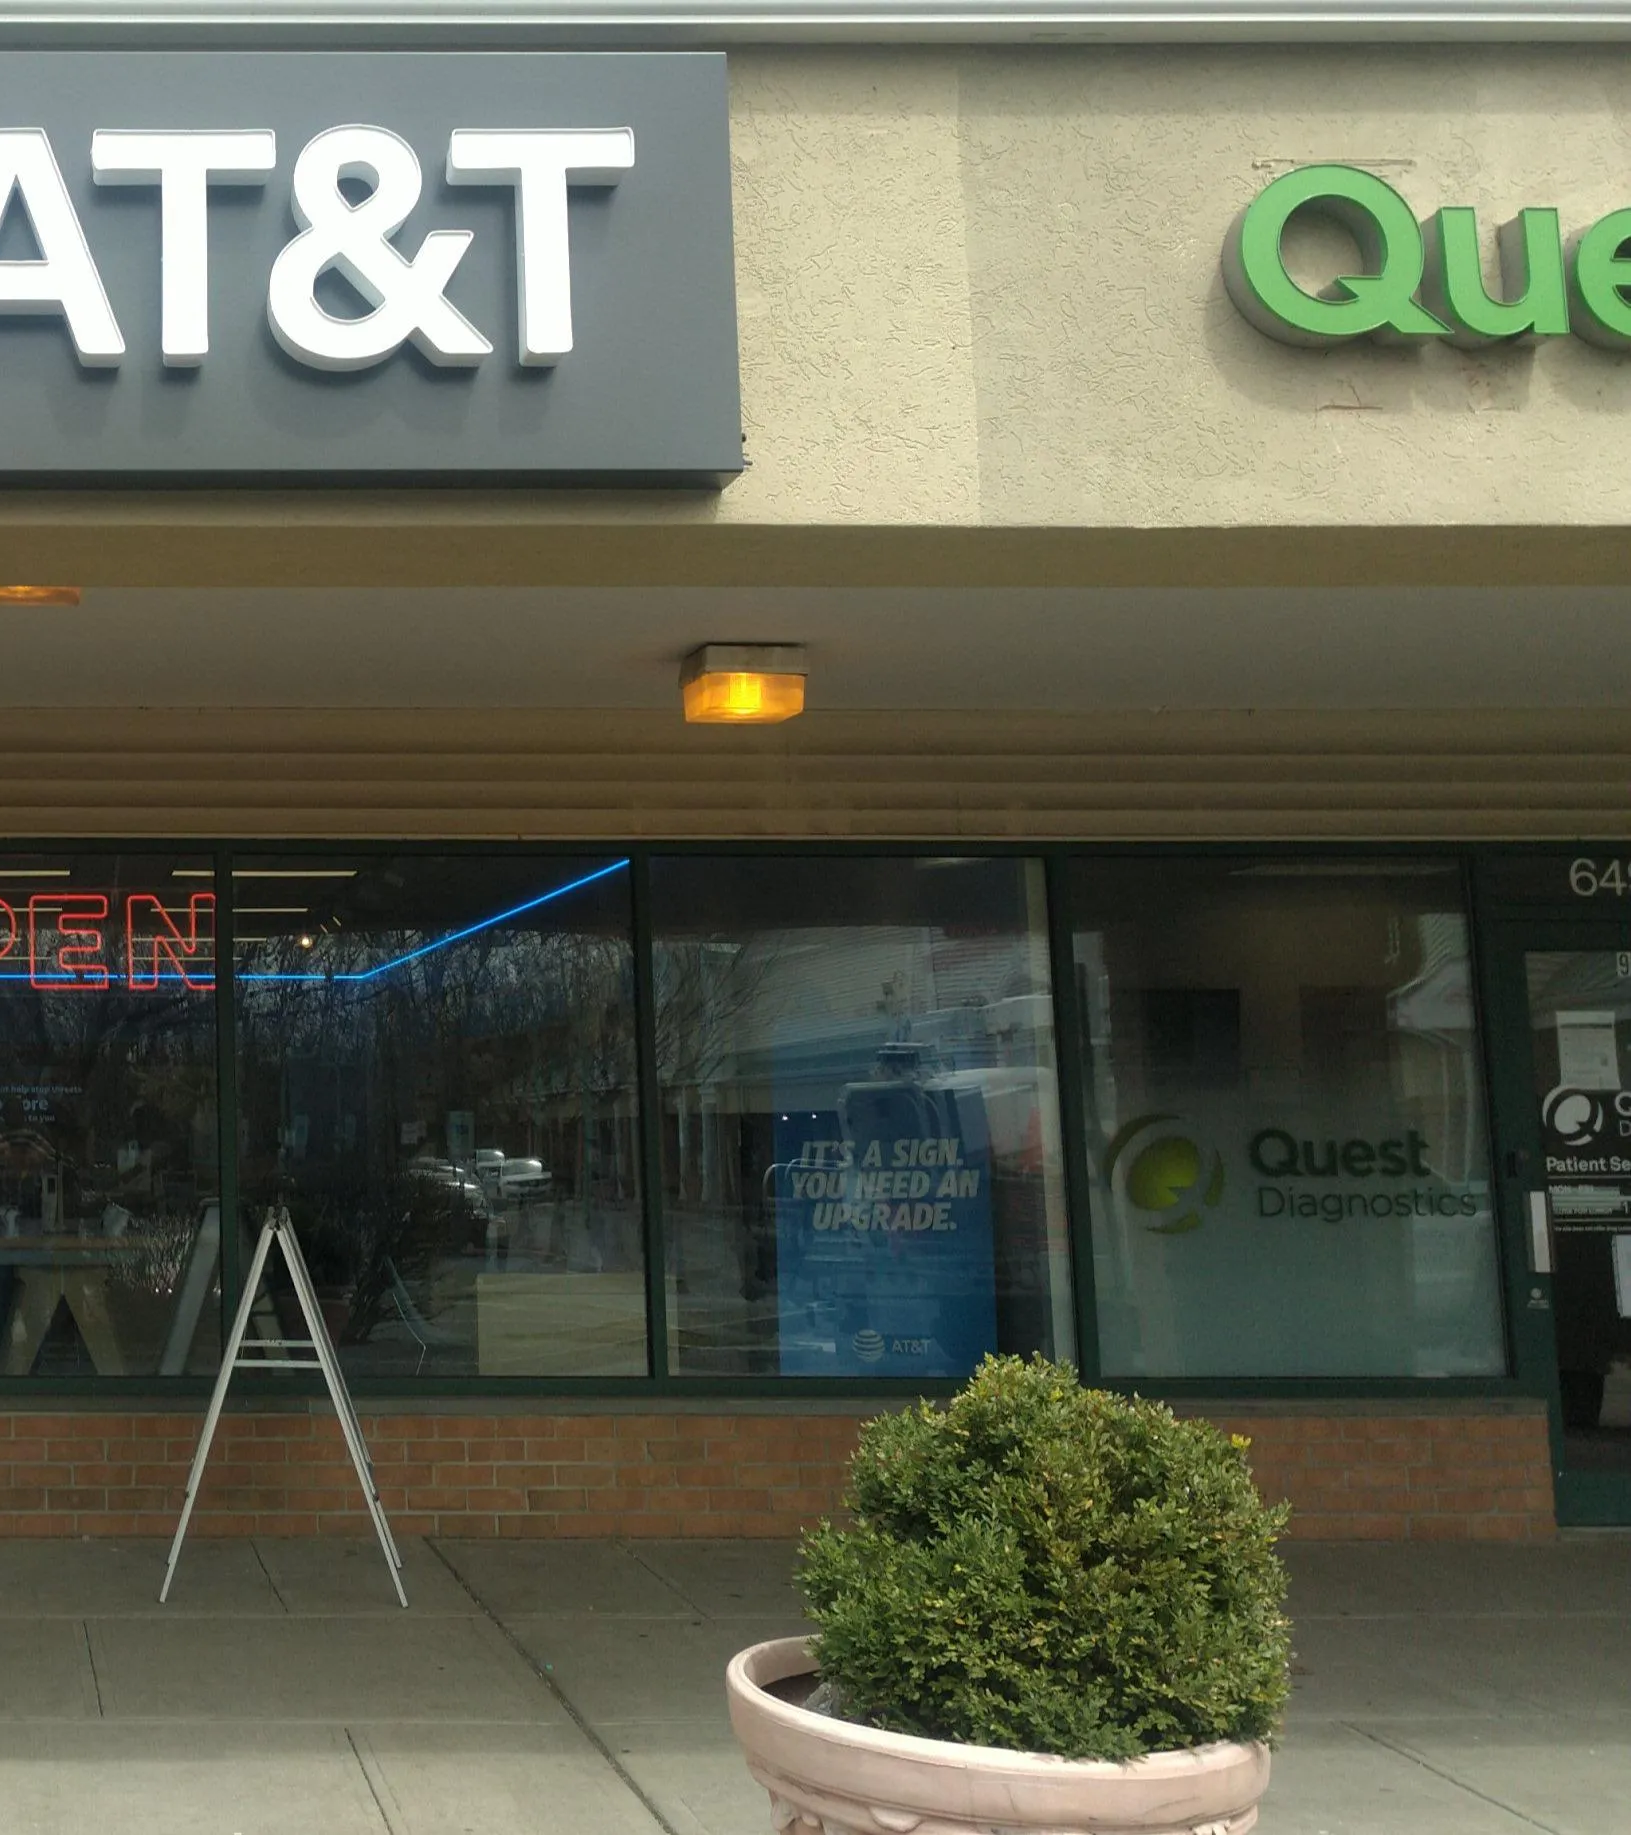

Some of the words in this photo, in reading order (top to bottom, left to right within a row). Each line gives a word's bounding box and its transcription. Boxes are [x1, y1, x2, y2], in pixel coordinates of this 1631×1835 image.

[1569, 858, 1631, 897] 64
[862, 1139, 883, 1167] A
[893, 1138, 965, 1167] SIGN.
[1249, 1128, 1431, 1178] Quest
[1546, 1156, 1607, 1173] Patient
[792, 1170, 848, 1200] YOU
[855, 1170, 931, 1200] NEED
[936, 1170, 980, 1199] AN
[813, 1202, 958, 1231] UPGRADE.
[1258, 1185, 1477, 1223] Diagnostics
[892, 1338, 931, 1354] AT&T
